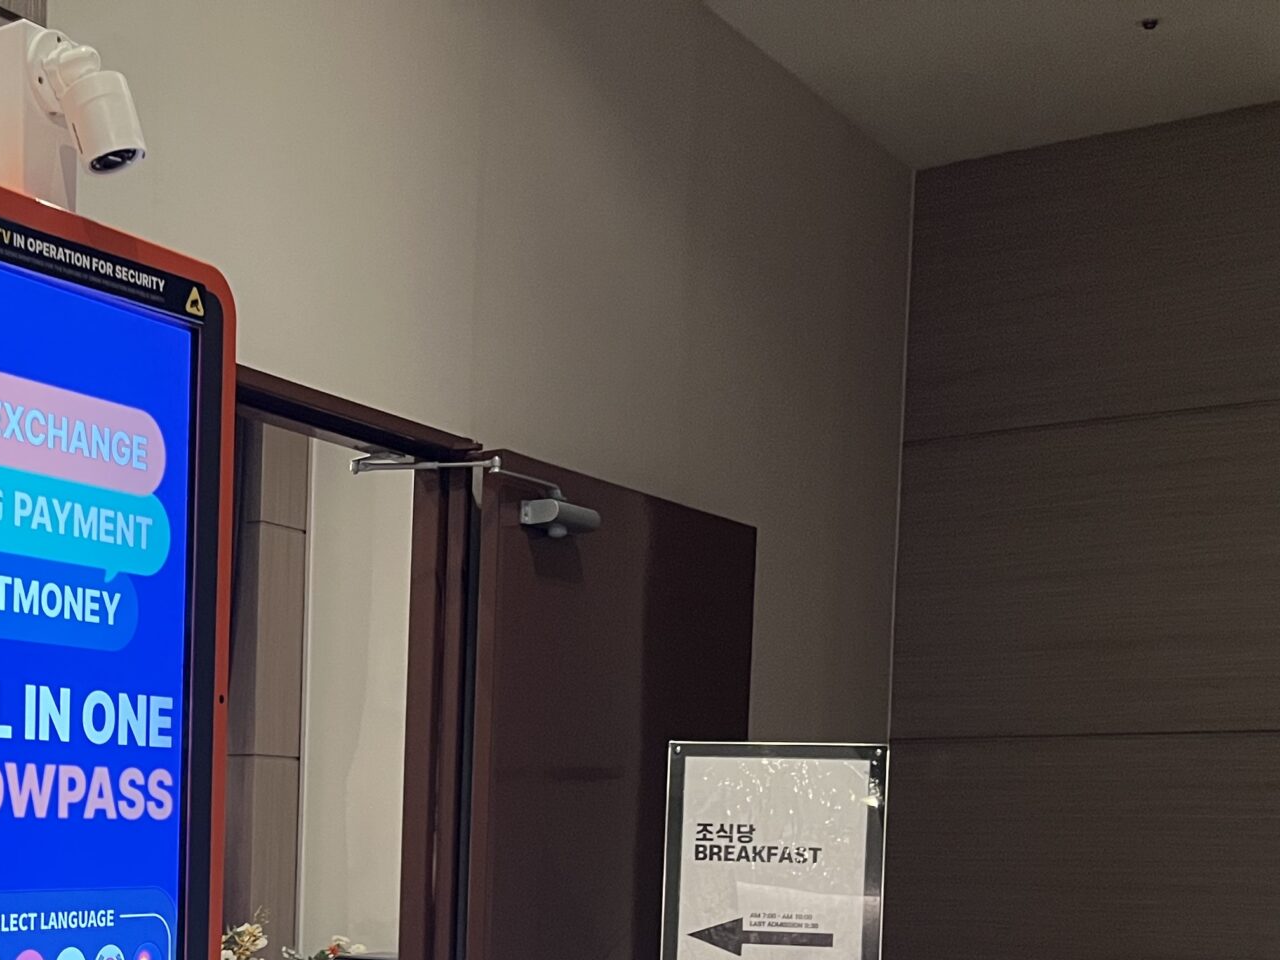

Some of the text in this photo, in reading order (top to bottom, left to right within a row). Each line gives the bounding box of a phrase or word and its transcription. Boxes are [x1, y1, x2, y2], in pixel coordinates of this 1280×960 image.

[13, 232, 25, 250] IN
[27, 237, 91, 270] OPERATION
[92, 257, 114, 277] FOR
[115, 266, 165, 293] SECURITY
[14, 490, 153, 550] PAYMENT
[24, 684, 71, 742] IN
[82, 690, 173, 748] ONE
[695, 823, 756, 844] 조식당
[694, 844, 822, 864] BREAKFAST
[40, 909, 115, 930] LANGUAGE
